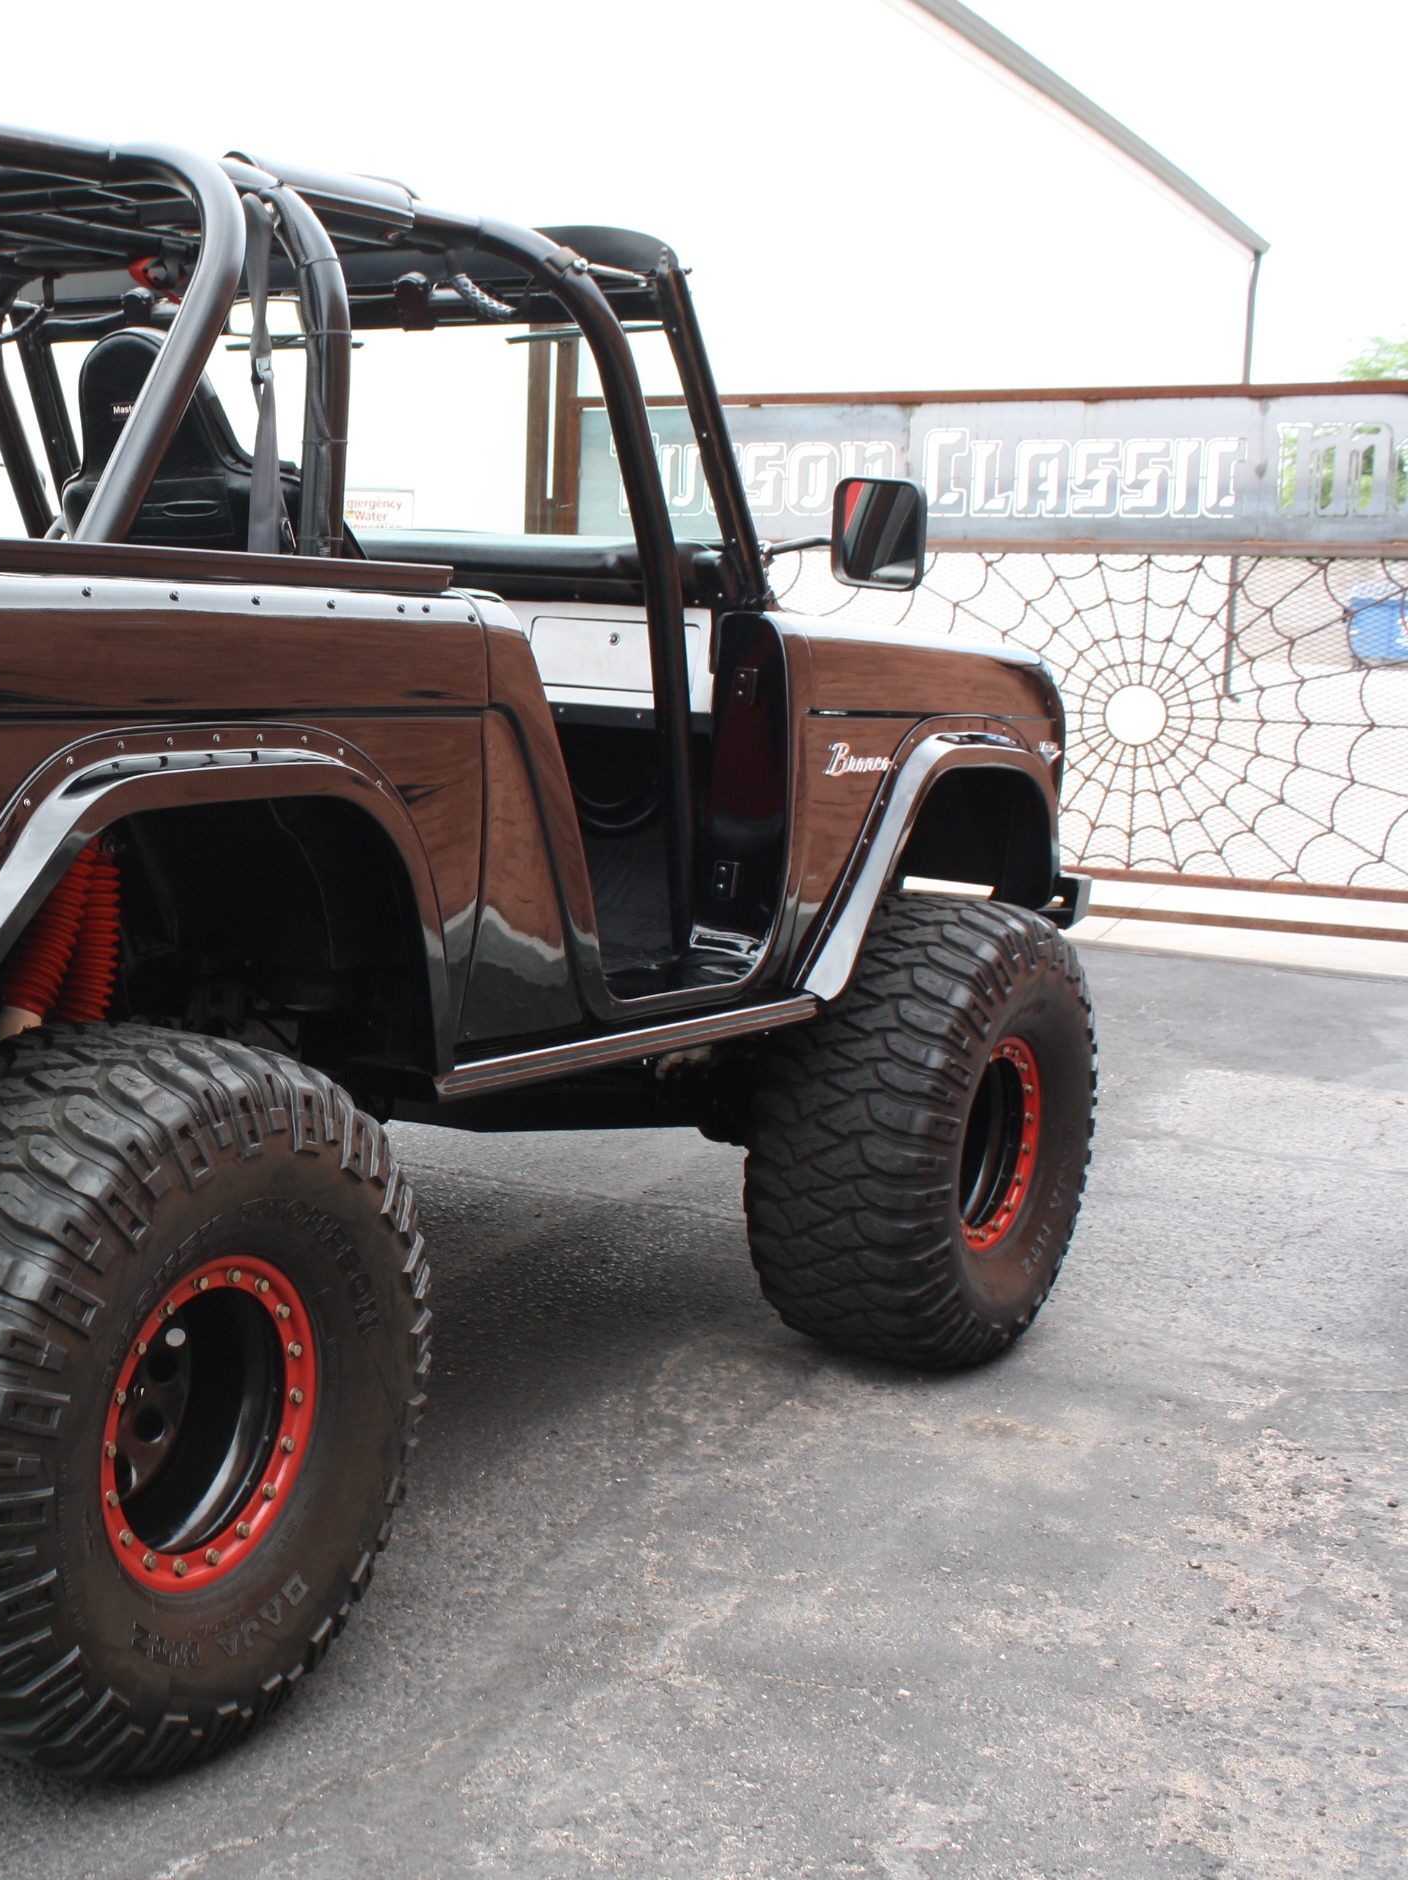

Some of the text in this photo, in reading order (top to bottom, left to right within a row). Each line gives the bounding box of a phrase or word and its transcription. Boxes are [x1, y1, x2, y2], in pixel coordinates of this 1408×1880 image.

[610, 422, 1408, 518] USON CLASSIC M
[345, 499, 403, 511] mergency
[354, 510, 388, 522] Water
[822, 742, 896, 777] Bronco
[214, 1569, 312, 1659] BAJA
